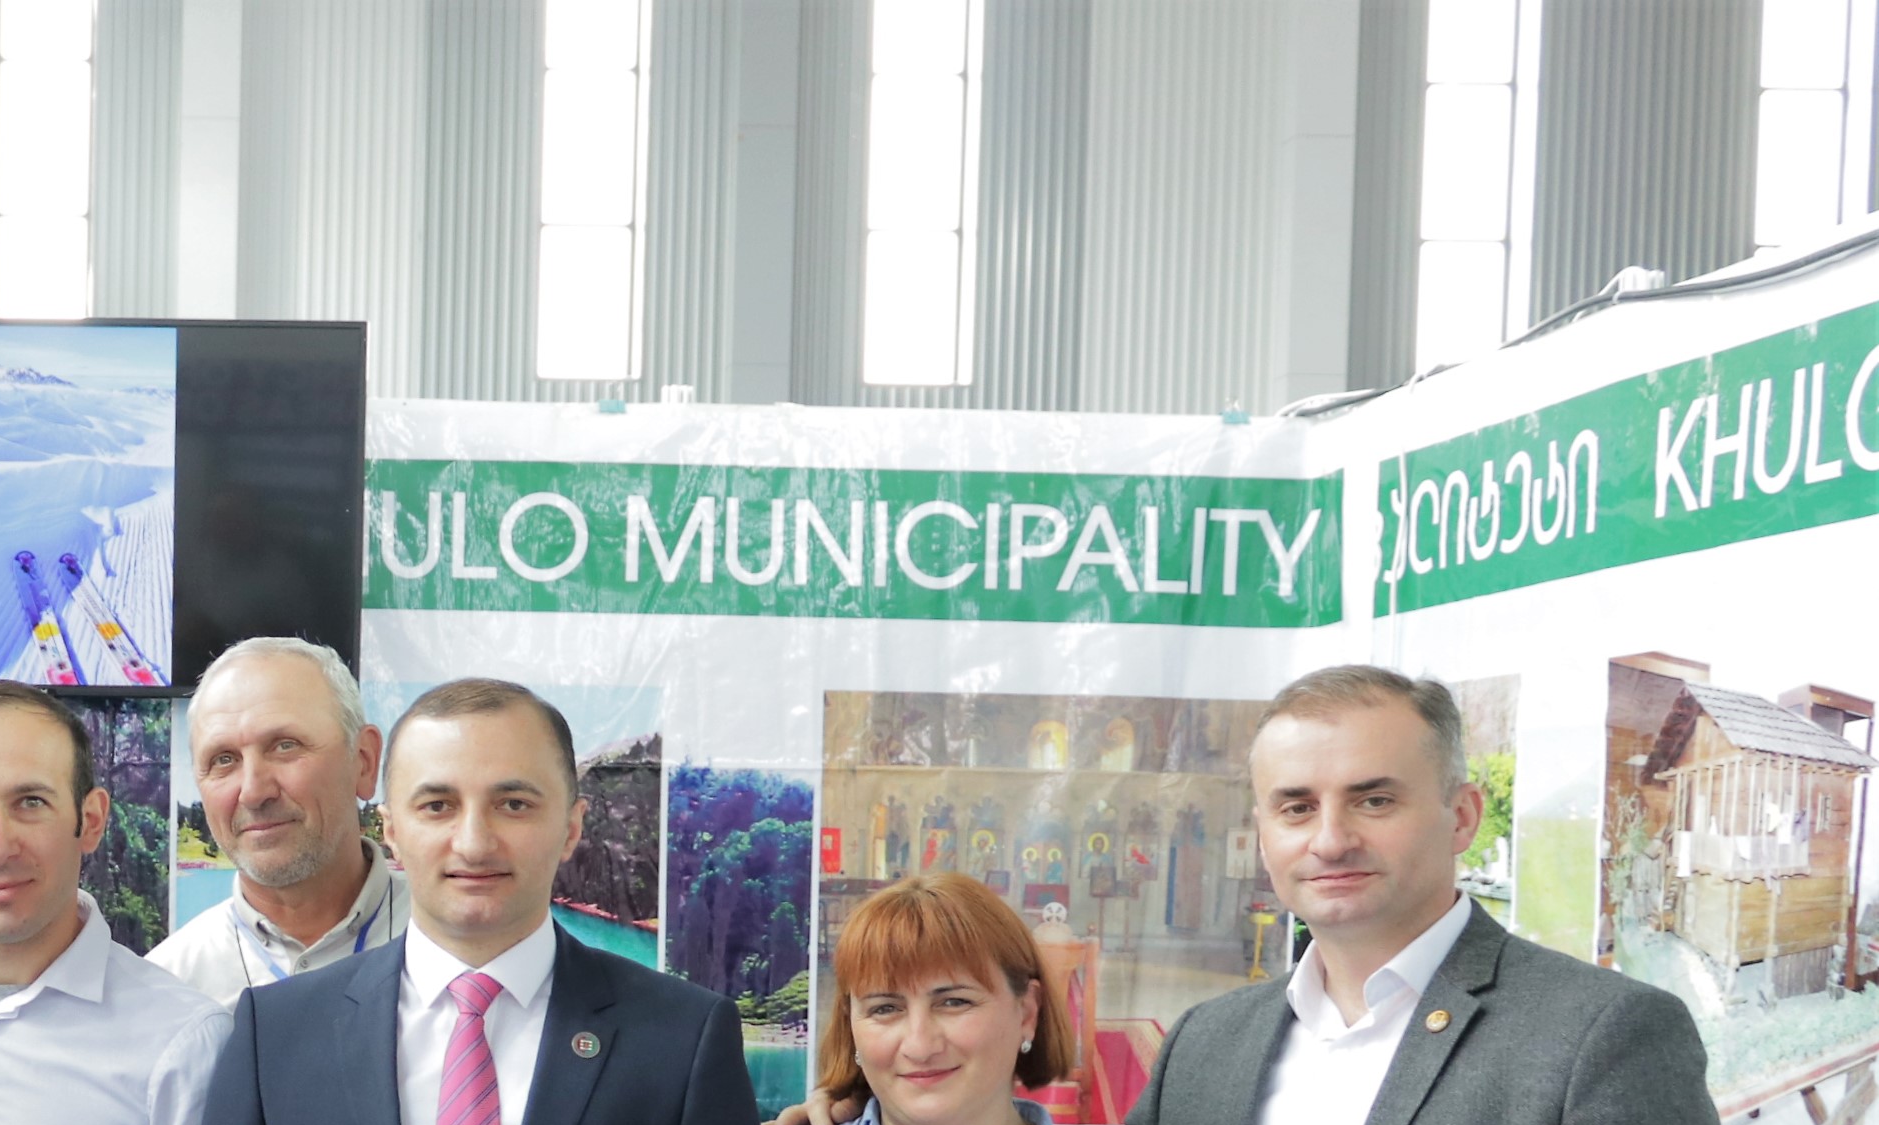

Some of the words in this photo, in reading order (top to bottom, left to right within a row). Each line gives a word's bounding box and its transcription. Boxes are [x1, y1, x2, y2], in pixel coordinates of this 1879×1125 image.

[362, 488, 589, 583] ULO
[623, 494, 1322, 598] MUNICIPALITY
[1377, 429, 1599, 584] ალიტეტი
